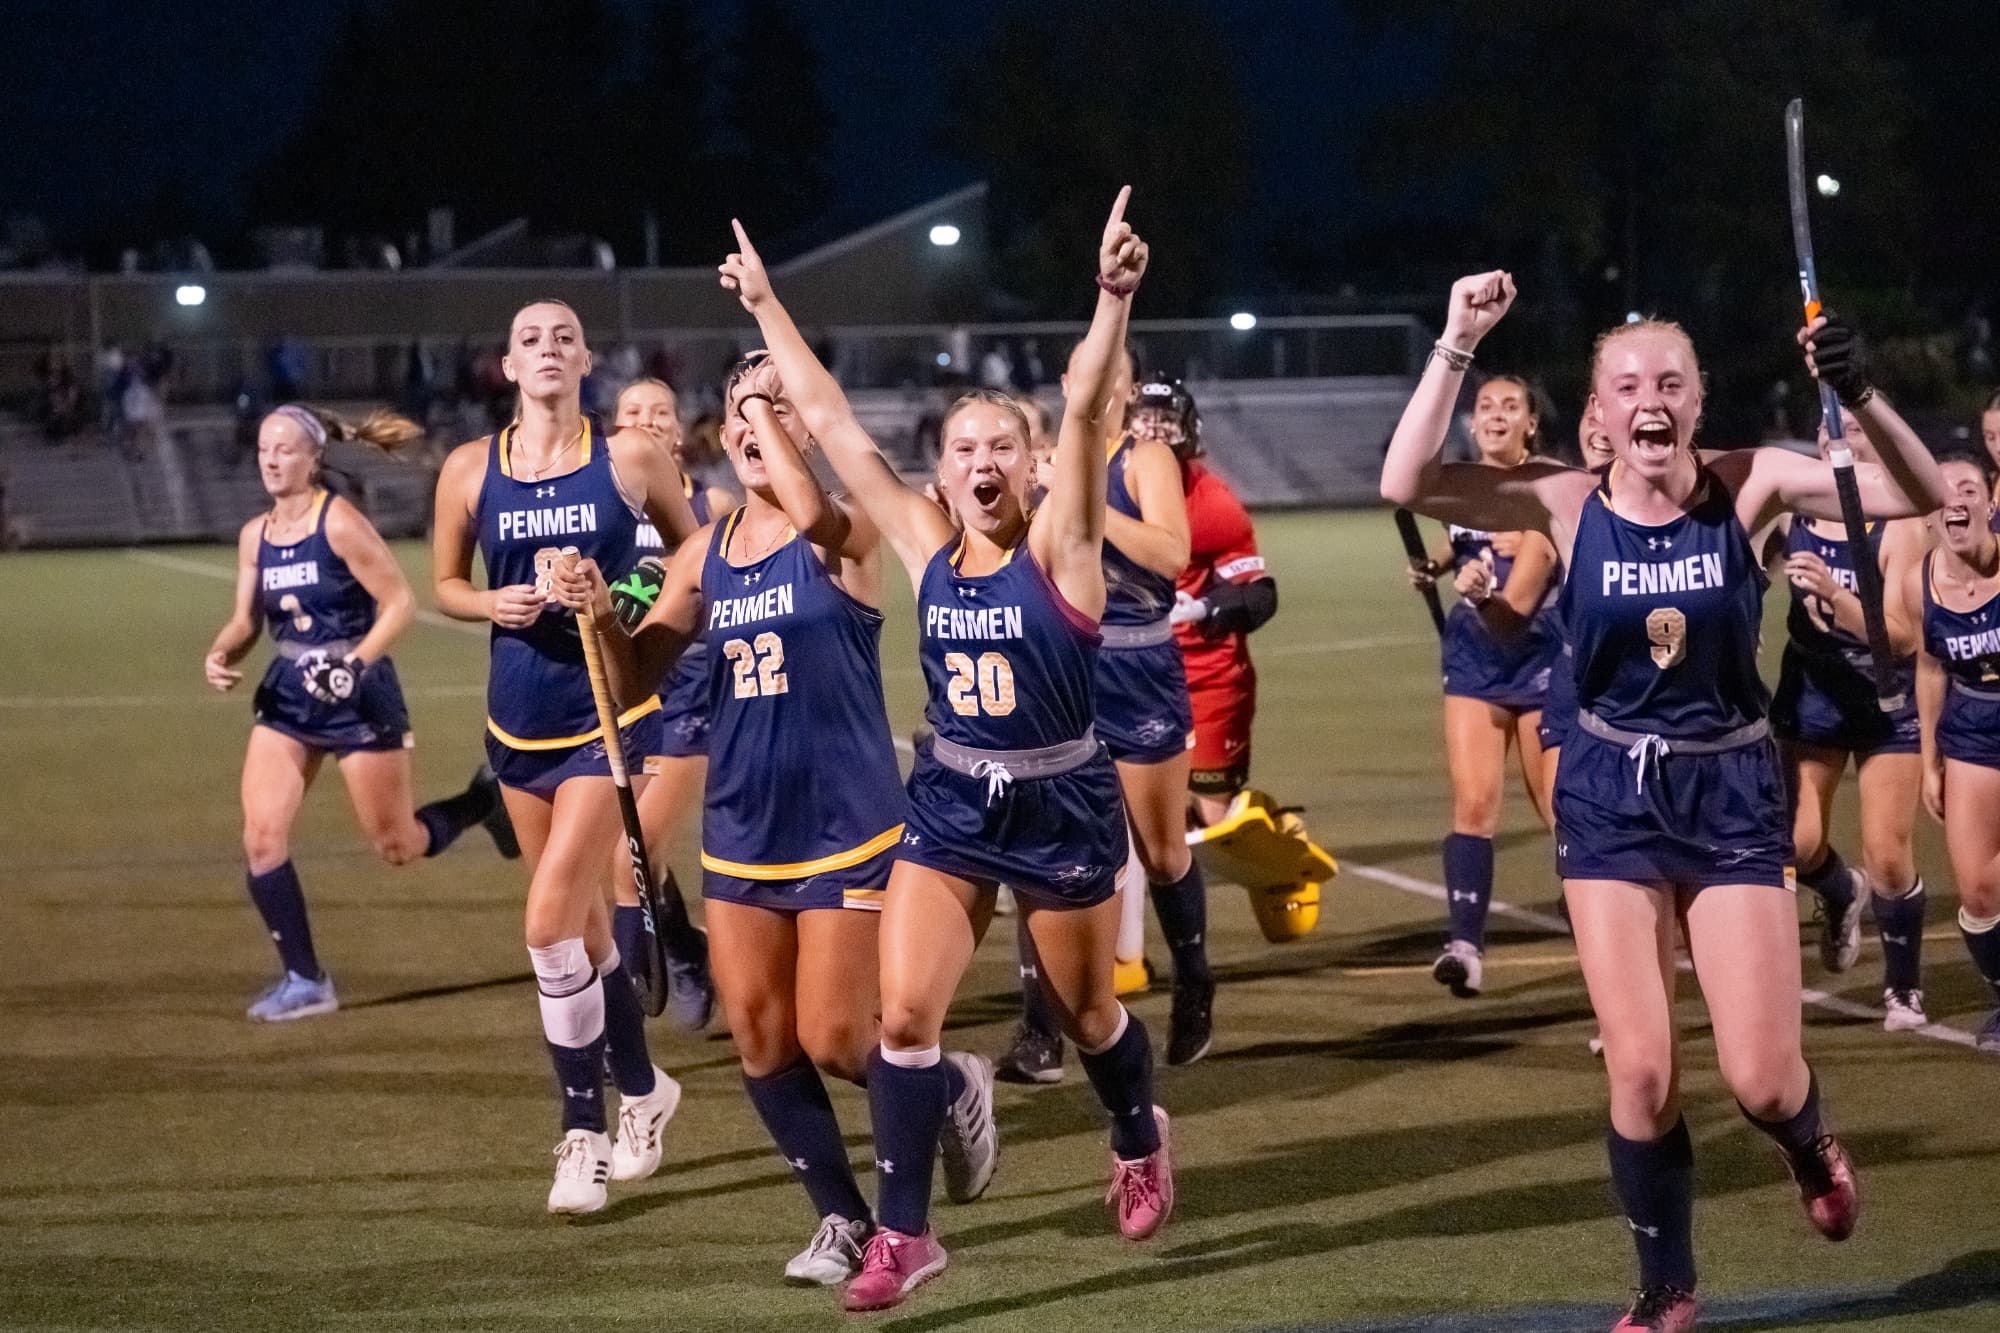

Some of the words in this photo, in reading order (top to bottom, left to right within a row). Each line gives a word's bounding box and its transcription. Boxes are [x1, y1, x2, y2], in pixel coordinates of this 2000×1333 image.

[499, 503, 597, 541] PENMEN
[263, 560, 319, 591] PENMEN
[1602, 552, 1724, 597] PENMEN
[708, 582, 794, 631] PENMEN
[926, 604, 1023, 640] PENMEN
[1645, 607, 1687, 670] 9
[722, 631, 789, 699] 22
[944, 651, 1017, 717] 20
